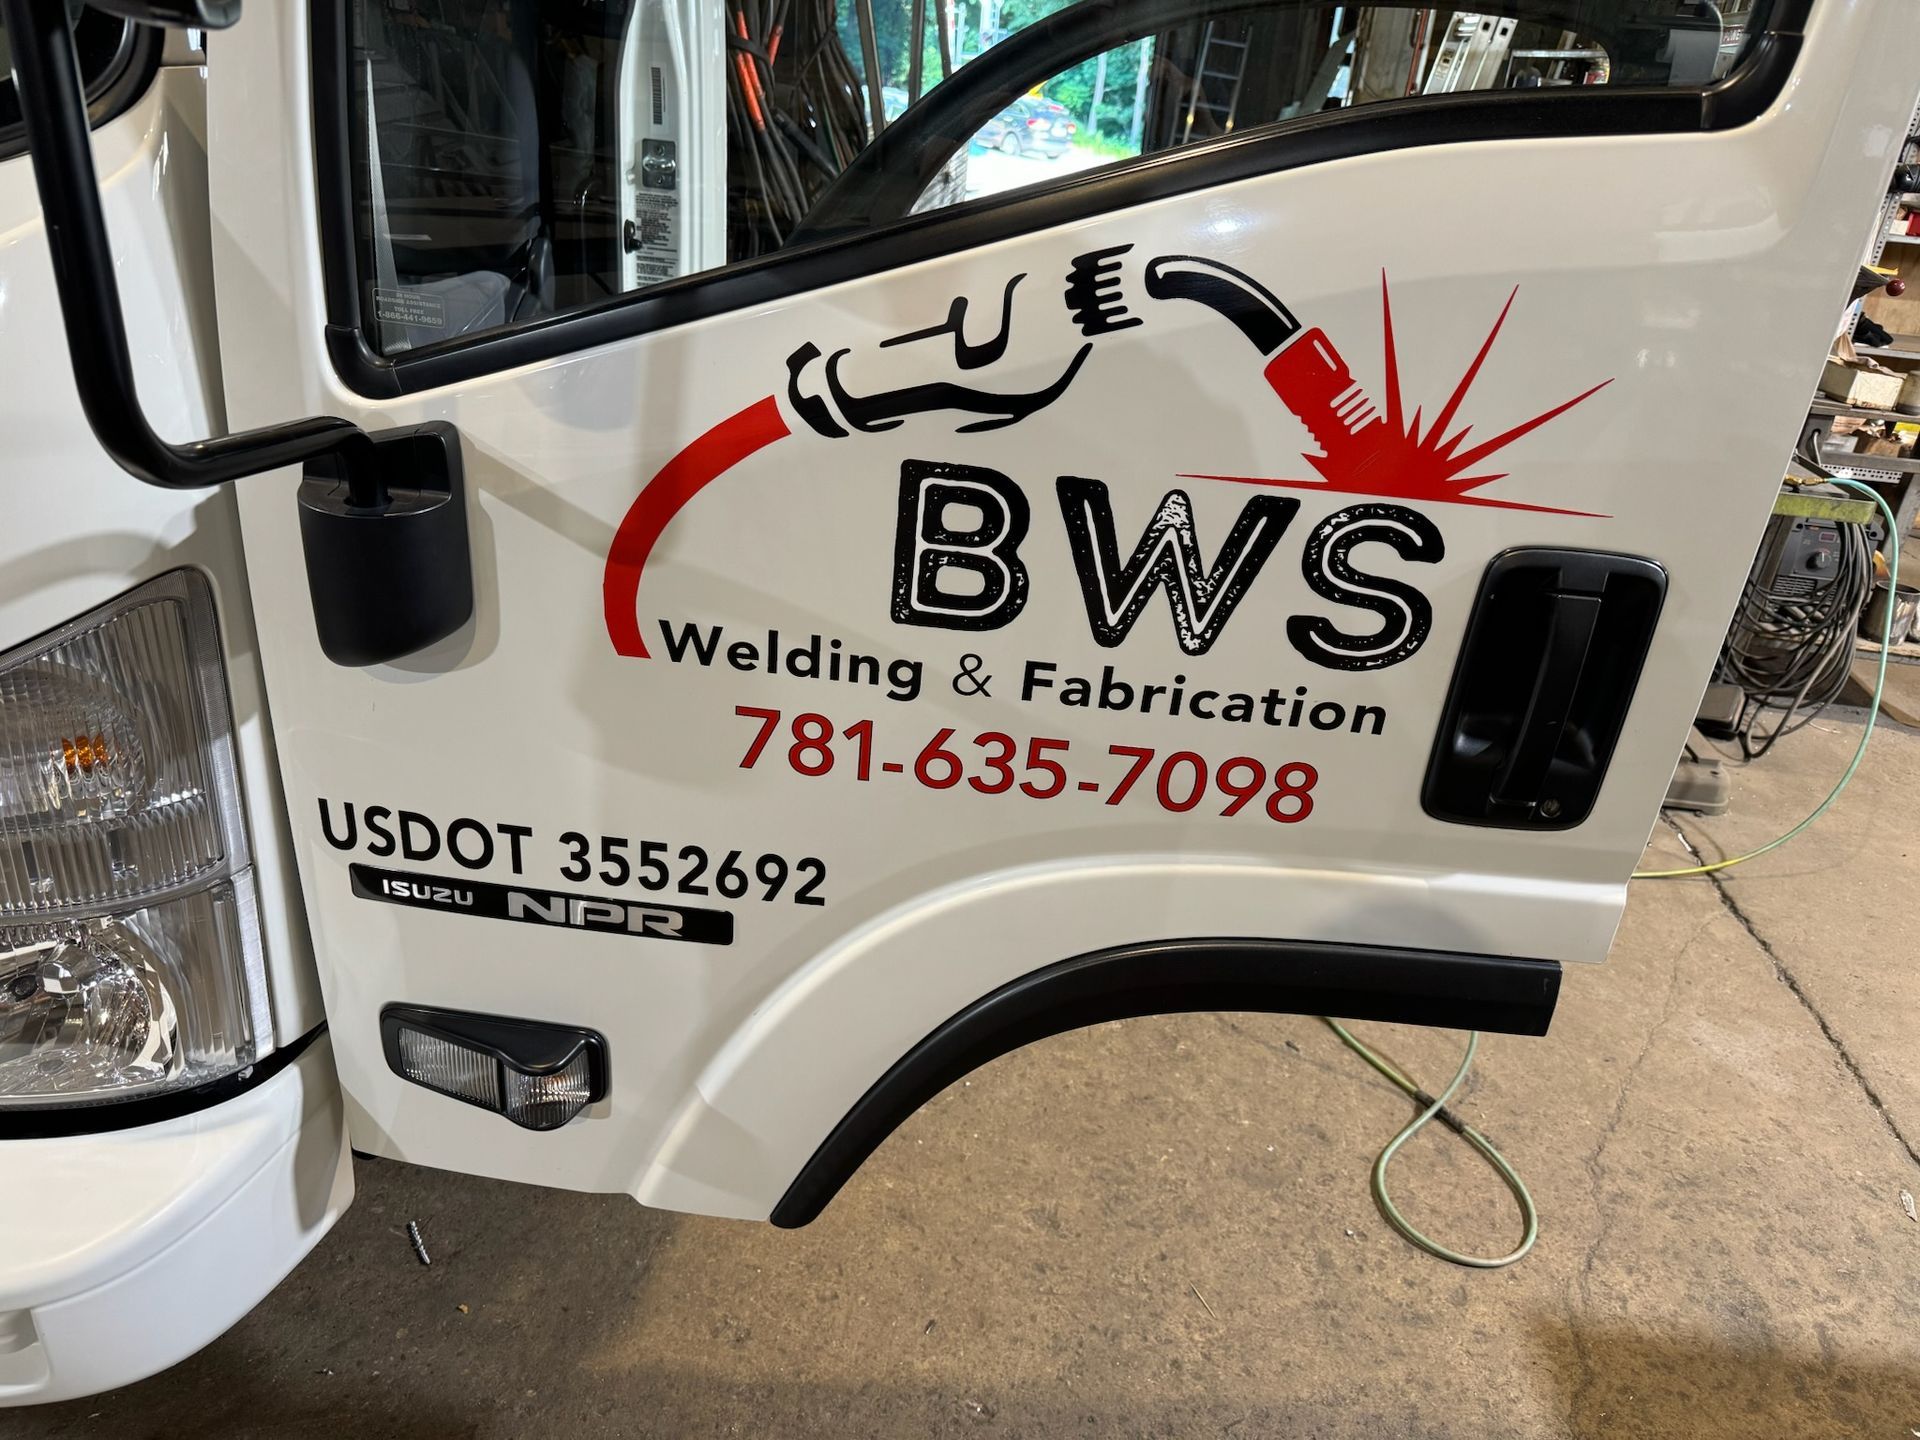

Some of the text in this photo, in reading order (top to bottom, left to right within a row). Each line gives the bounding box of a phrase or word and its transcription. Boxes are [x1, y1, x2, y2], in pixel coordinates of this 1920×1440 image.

[890, 459, 1445, 672] BWS
[658, 619, 1386, 735] Welding & Fabrication
[735, 705, 1318, 823] 781-635-7098
[318, 798, 826, 906] USDOT 3552692
[382, 878, 683, 937] ISUZU NPR
